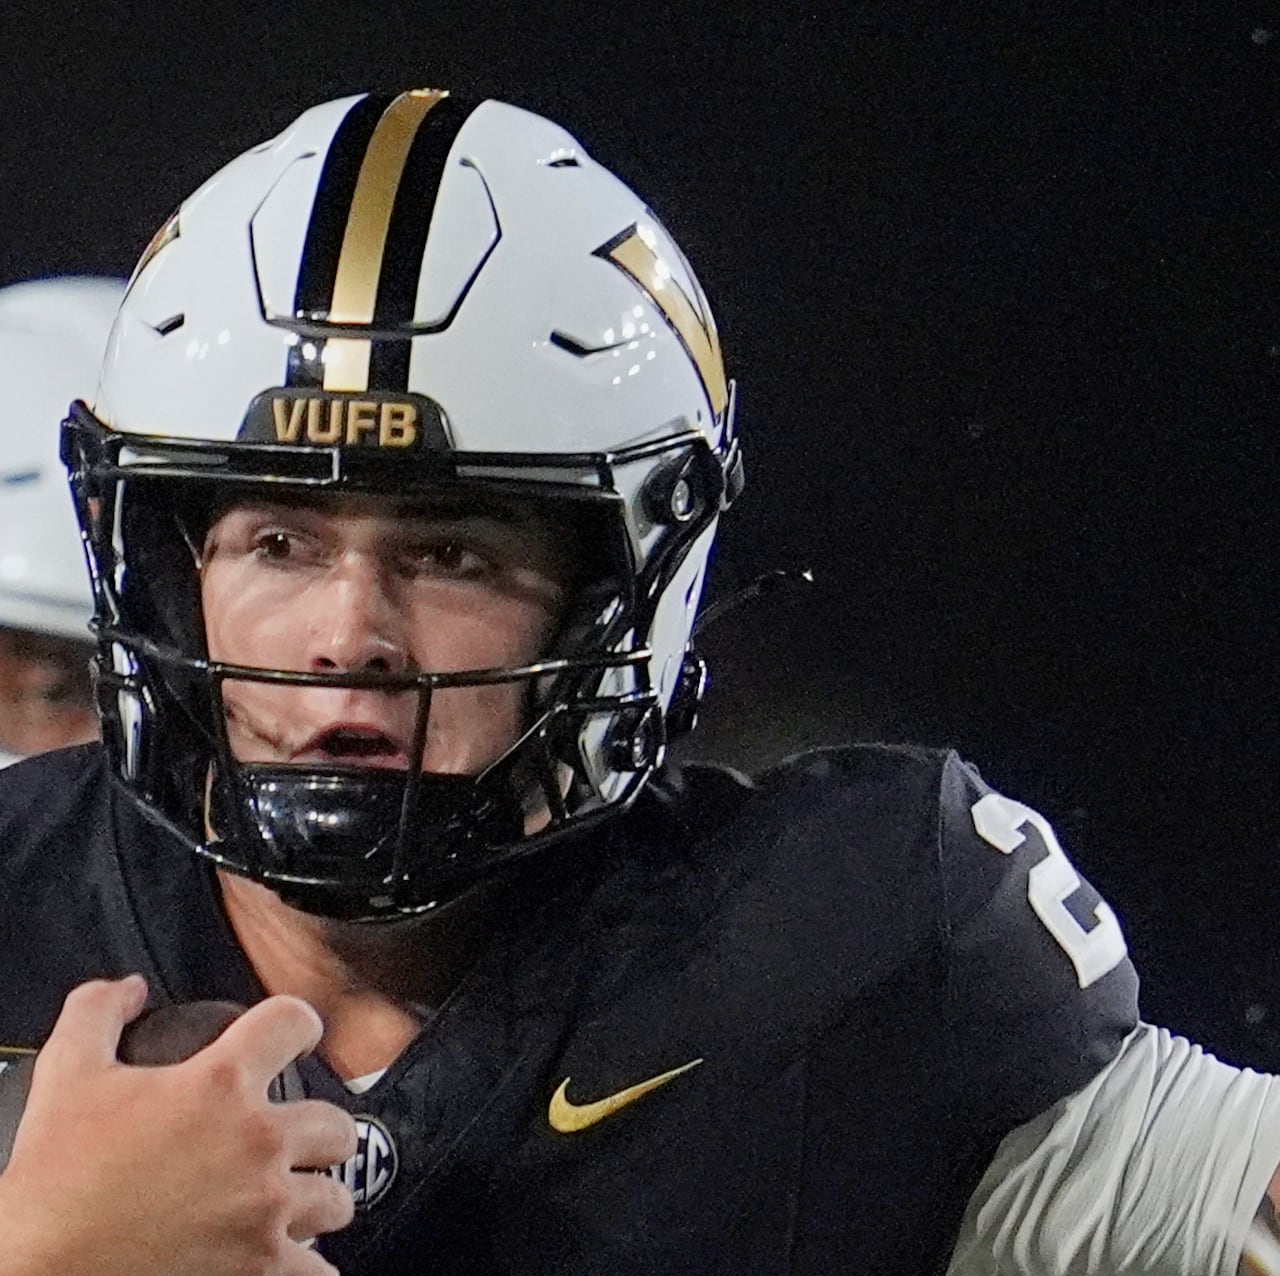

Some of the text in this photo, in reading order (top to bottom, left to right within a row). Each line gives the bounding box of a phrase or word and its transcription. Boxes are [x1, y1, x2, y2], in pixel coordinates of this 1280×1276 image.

[272, 398, 417, 449] VUFB
[970, 793, 1127, 989] 2
[330, 1120, 391, 1203] EC
